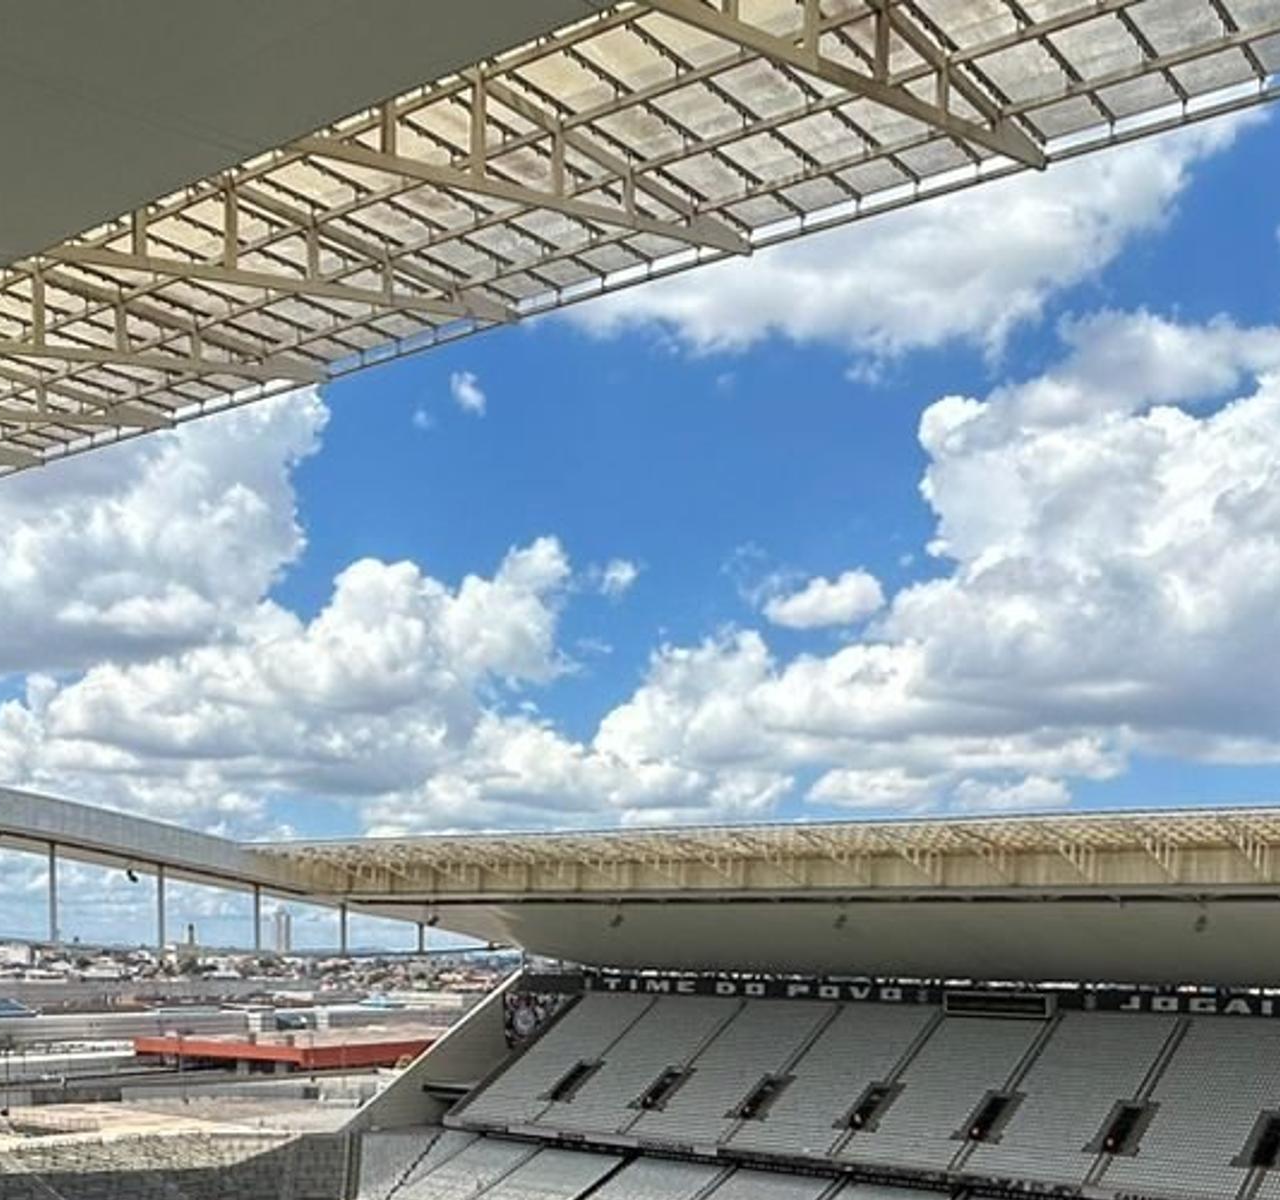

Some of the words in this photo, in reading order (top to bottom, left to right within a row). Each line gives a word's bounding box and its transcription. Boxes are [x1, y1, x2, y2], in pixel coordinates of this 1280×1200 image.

[603, 978, 696, 993] TIME
[716, 981, 765, 996] DO
[787, 984, 902, 1000] POVO
[1120, 996, 1273, 1014] JOGAI
